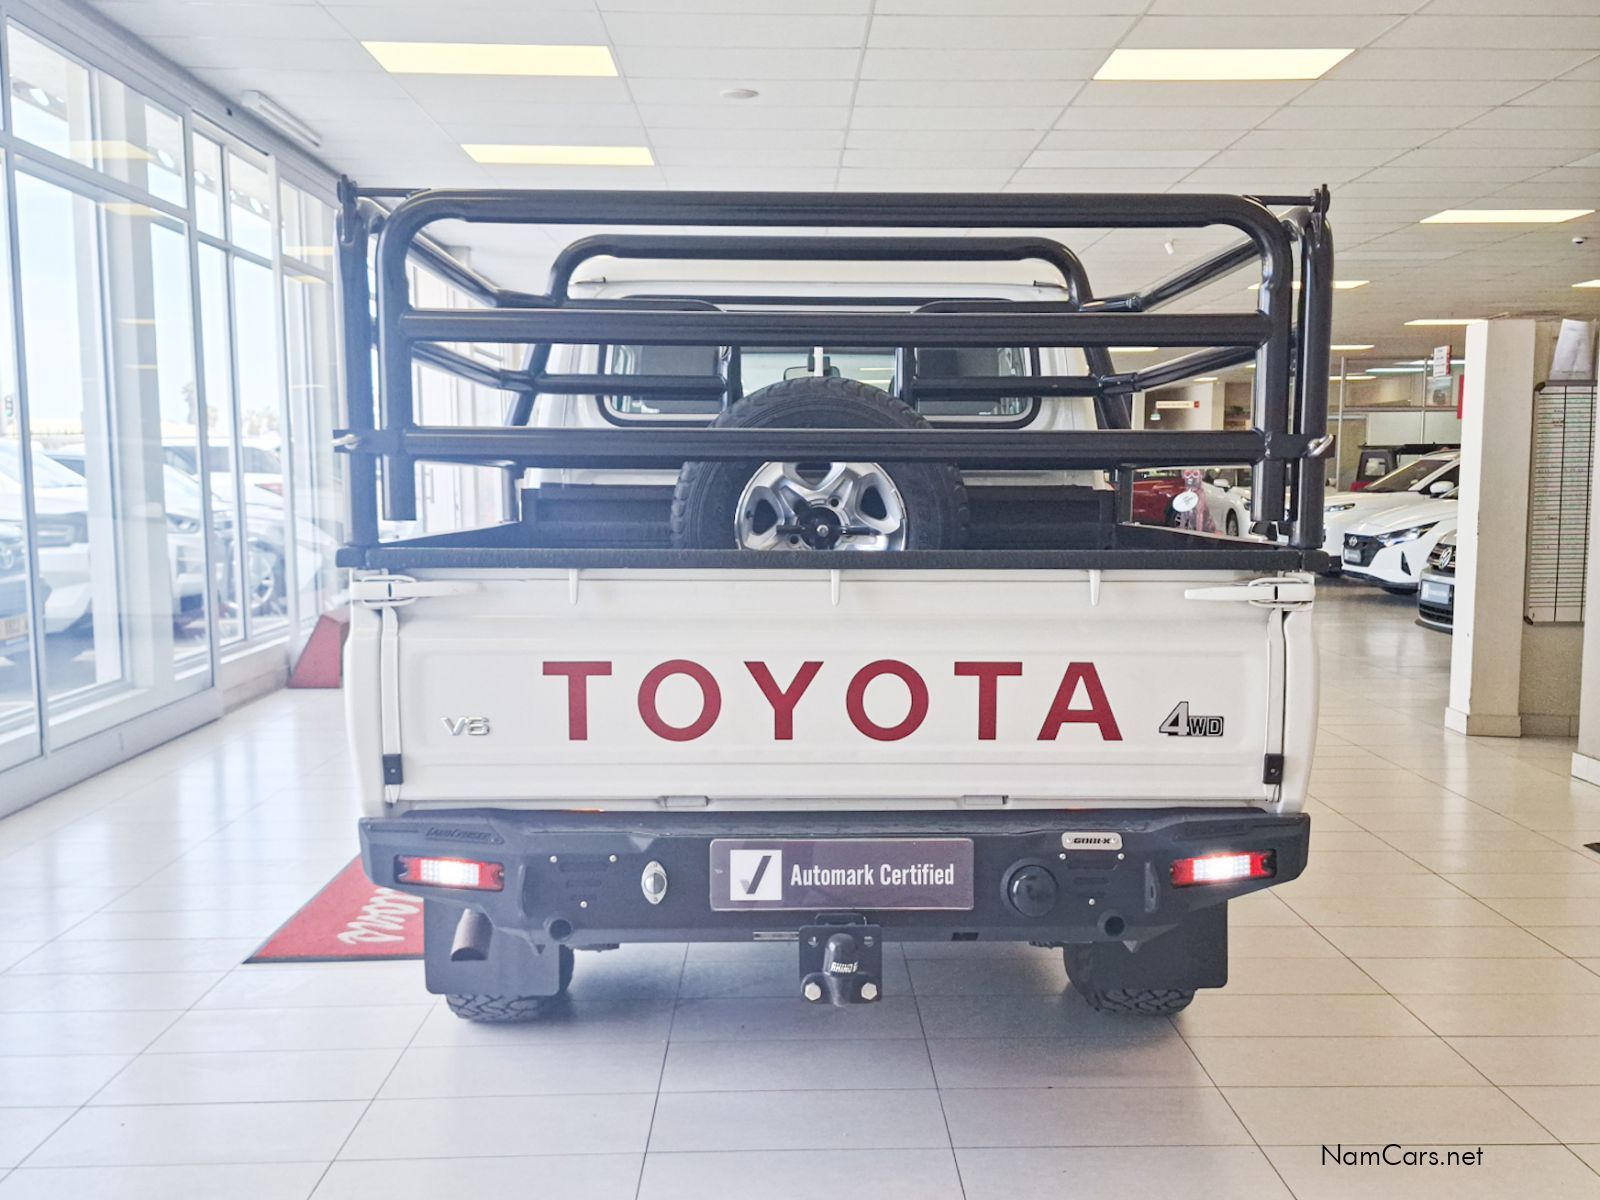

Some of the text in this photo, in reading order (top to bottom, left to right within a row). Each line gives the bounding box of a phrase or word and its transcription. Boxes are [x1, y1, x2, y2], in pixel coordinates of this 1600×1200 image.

[543, 659, 1123, 741] TOYOTA
[1159, 701, 1224, 737] 4WD
[790, 863, 954, 886] Automark Certified
